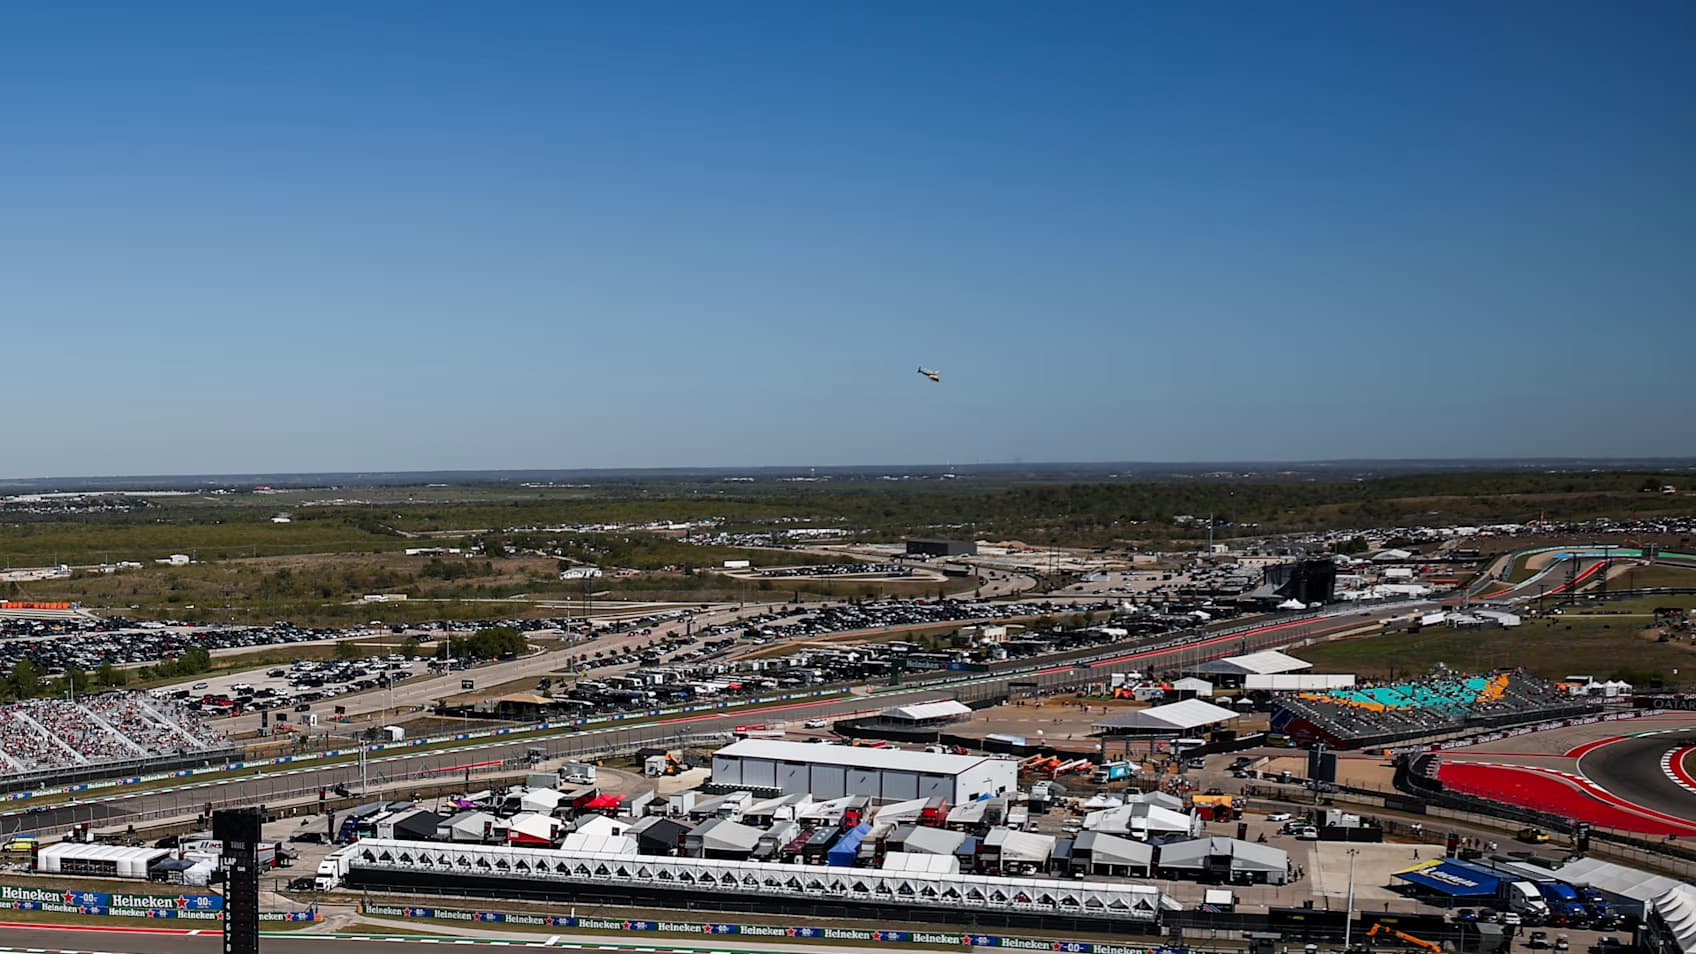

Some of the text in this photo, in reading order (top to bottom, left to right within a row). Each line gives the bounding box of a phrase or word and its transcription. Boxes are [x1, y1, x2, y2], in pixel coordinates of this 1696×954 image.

[226, 871, 230, 879] 1
[225, 882, 231, 890] 2
[2, 887, 59, 902] Heineken
[113, 895, 173, 907] Heineken
[225, 902, 231, 910] 4
[41, 903, 77, 912] Heineken
[109, 907, 145, 917] Heineken
[365, 906, 402, 916] Heineken
[177, 910, 215, 920] Heineken
[225, 913, 231, 921] 5
[259, 911, 284, 921] neken
[435, 910, 471, 920] Heineken
[506, 914, 544, 924] Heineken
[225, 923, 231, 931] 6
[579, 919, 620, 929] Heineken
[658, 922, 701, 933] Heineken
[740, 925, 785, 937] Heineken
[824, 929, 870, 940] Heineken
[226, 933, 231, 941] 7
[912, 932, 960, 945] Heineken
[226, 944, 231, 952] 8
[1001, 937, 1050, 950] Heineken
